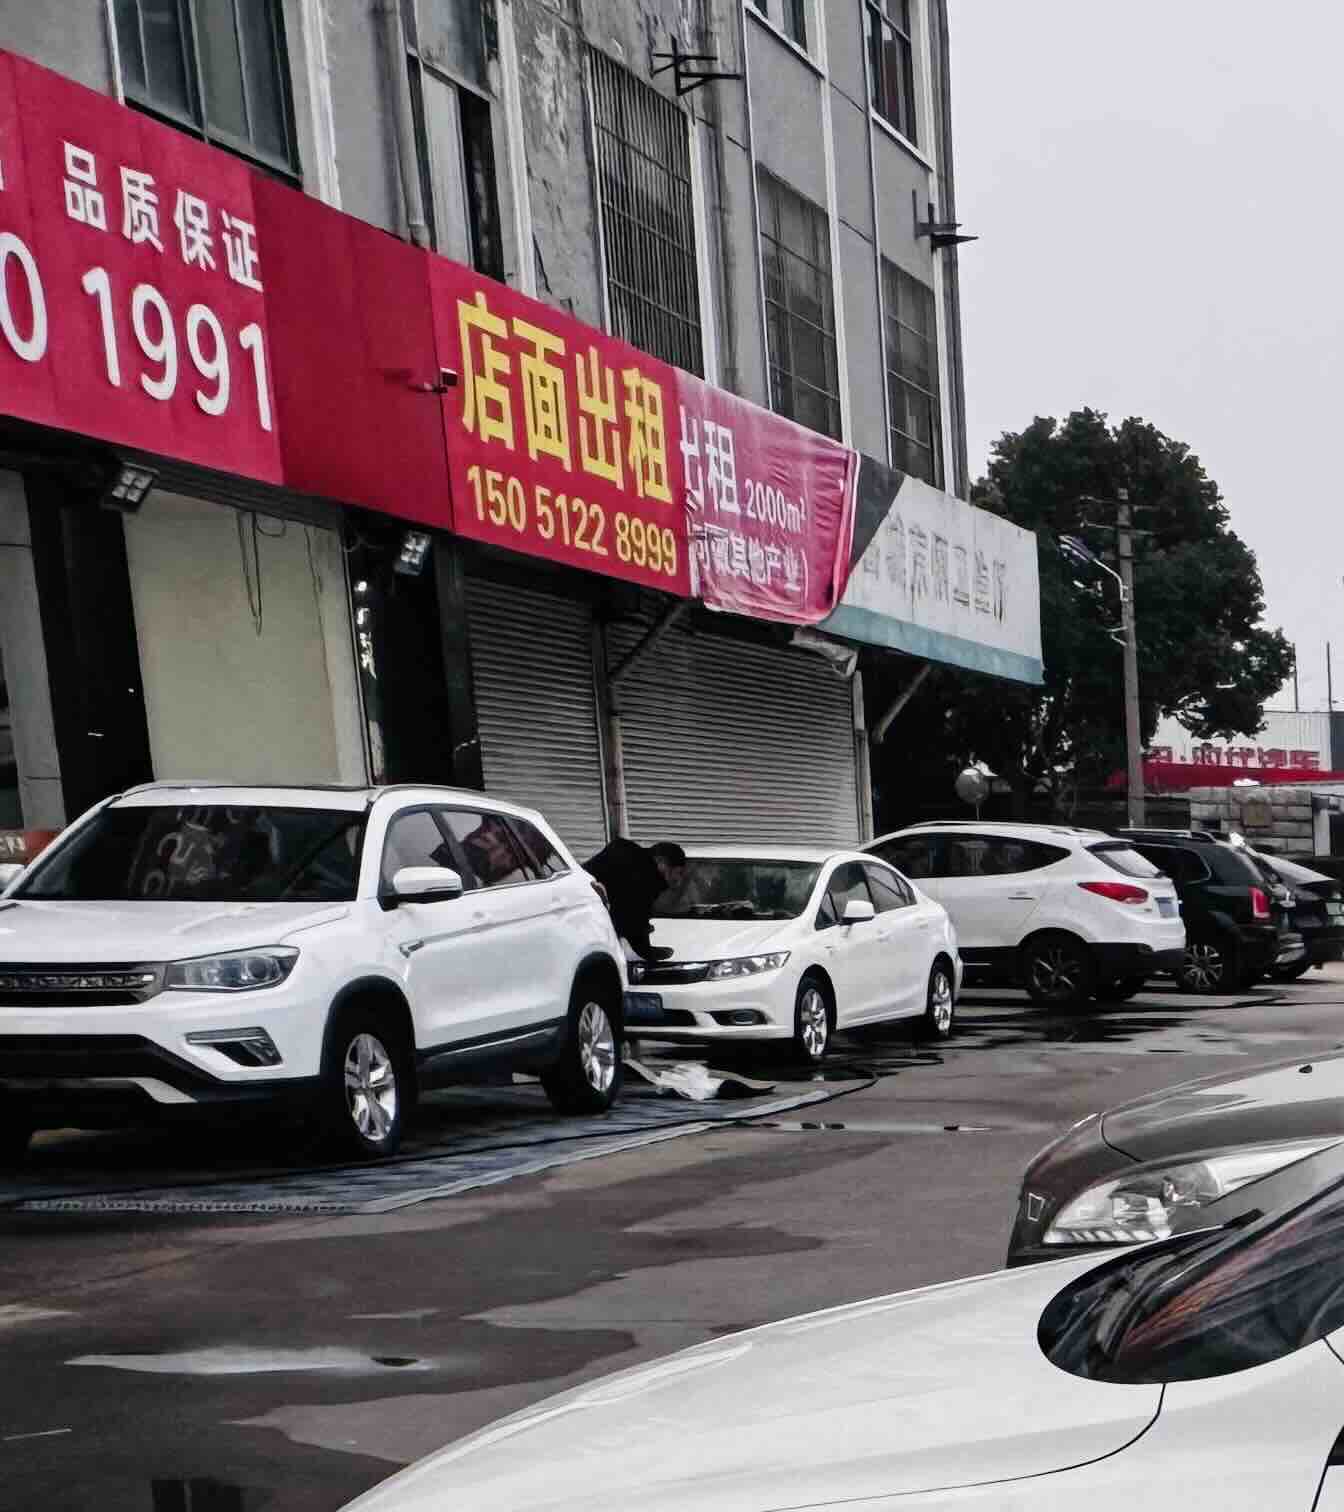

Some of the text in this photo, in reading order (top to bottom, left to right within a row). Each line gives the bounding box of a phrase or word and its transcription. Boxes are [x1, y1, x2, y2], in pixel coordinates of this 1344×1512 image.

[62, 140, 264, 293] 品质保证
[81, 266, 272, 432] 1991
[457, 291, 672, 504] 店面出租
[467, 465, 677, 576] 150 5122 8999
